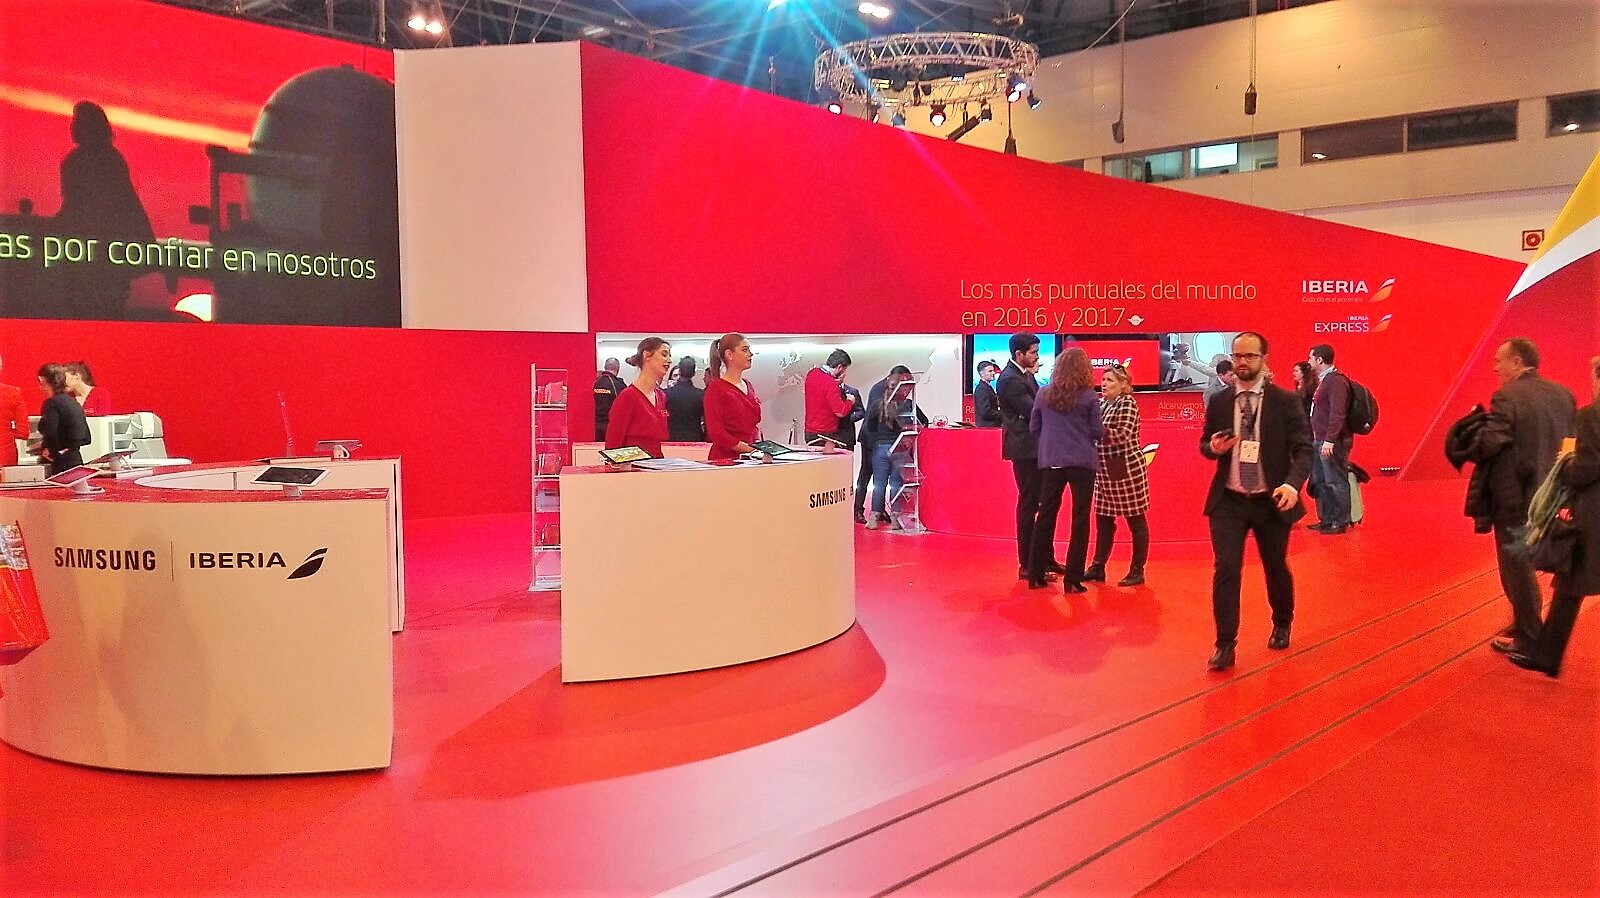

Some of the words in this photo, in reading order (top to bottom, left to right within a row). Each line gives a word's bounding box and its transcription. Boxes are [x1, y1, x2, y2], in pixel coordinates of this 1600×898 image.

[43, 236, 98, 268] por
[107, 238, 214, 270] confiar
[223, 248, 256, 272] en
[266, 251, 377, 280] nosotros
[960, 279, 994, 300] Los
[1000, 278, 1044, 300] más
[1048, 279, 1147, 305] puntuales
[1151, 279, 1182, 300] del
[1187, 279, 1257, 301] mundo
[1302, 279, 1369, 294] IBERIA
[961, 311, 988, 327] en
[993, 307, 1047, 328] 2016
[1053, 311, 1066, 331] y
[1071, 307, 1125, 327] 2017
[1314, 322, 1369, 333] EXPRESS
[1090, 358, 1120, 367] BERIA
[54, 546, 156, 572] SAMSUNG
[189, 551, 287, 569] IBERIA
